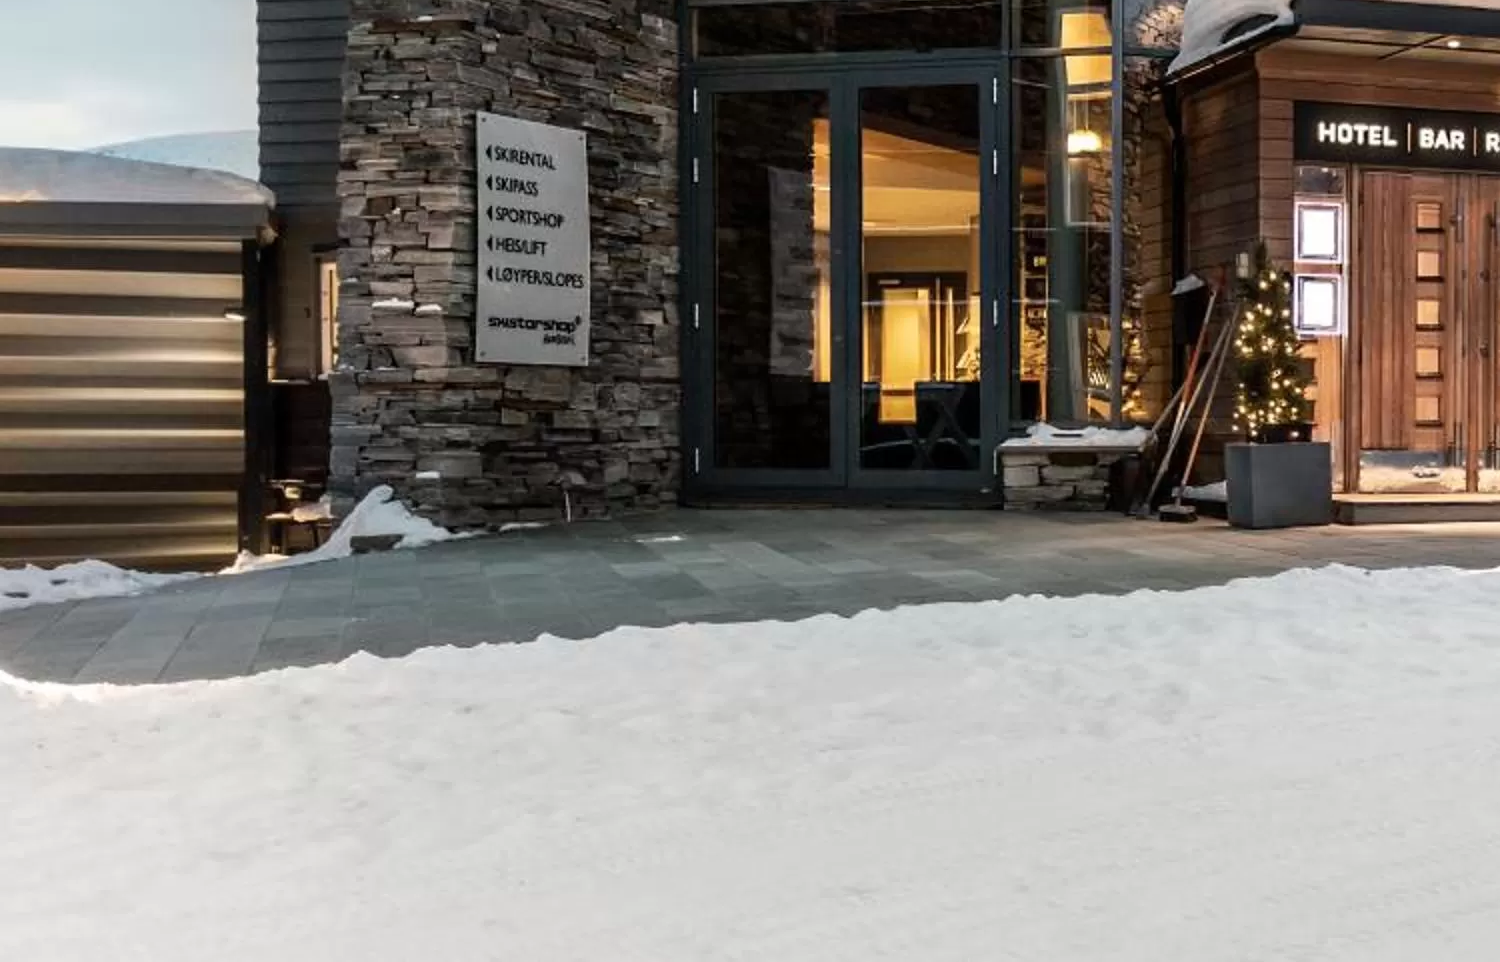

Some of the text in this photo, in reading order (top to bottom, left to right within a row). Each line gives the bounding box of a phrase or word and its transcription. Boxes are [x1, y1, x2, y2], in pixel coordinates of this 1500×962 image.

[1317, 121, 1398, 147] HOTEL
[1418, 128, 1466, 150] BAR
[494, 145, 557, 170] SKIRENTAL
[495, 176, 539, 197] SKIPASS
[495, 205, 565, 228] SPORTSHOP
